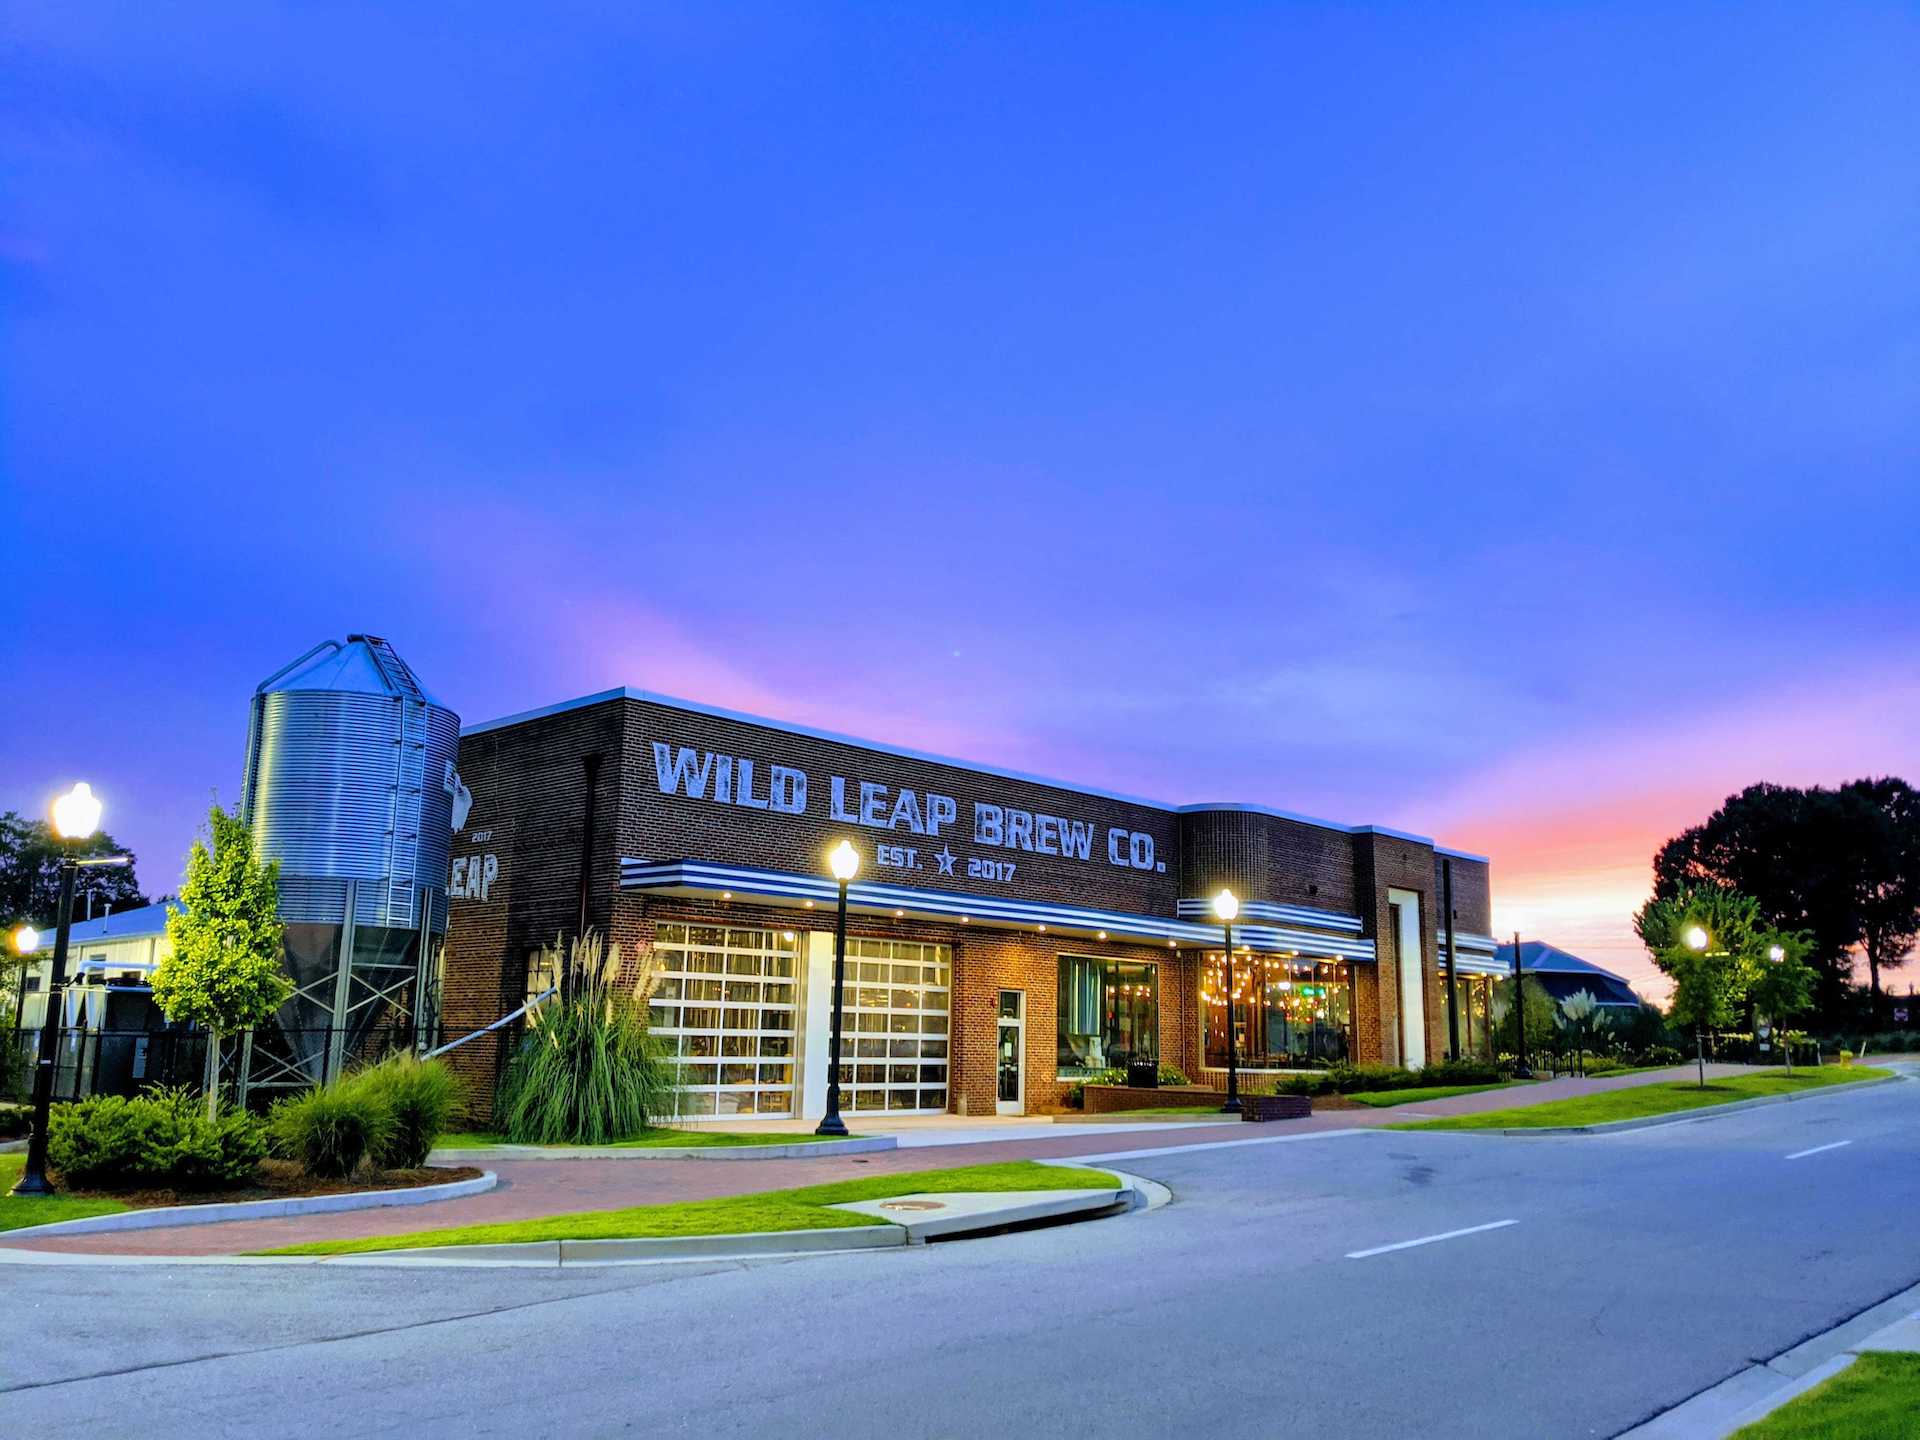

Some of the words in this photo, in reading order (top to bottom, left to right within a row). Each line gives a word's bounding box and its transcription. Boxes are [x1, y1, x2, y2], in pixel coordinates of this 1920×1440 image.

[652, 741, 808, 814] WILD
[830, 775, 957, 836] LEAP
[974, 802, 1095, 861] BREW
[1107, 827, 1167, 873] CO.
[471, 830, 494, 843] 2017
[445, 854, 498, 902] EAP
[877, 844, 923, 870] EST.
[967, 857, 1017, 881] 2017
